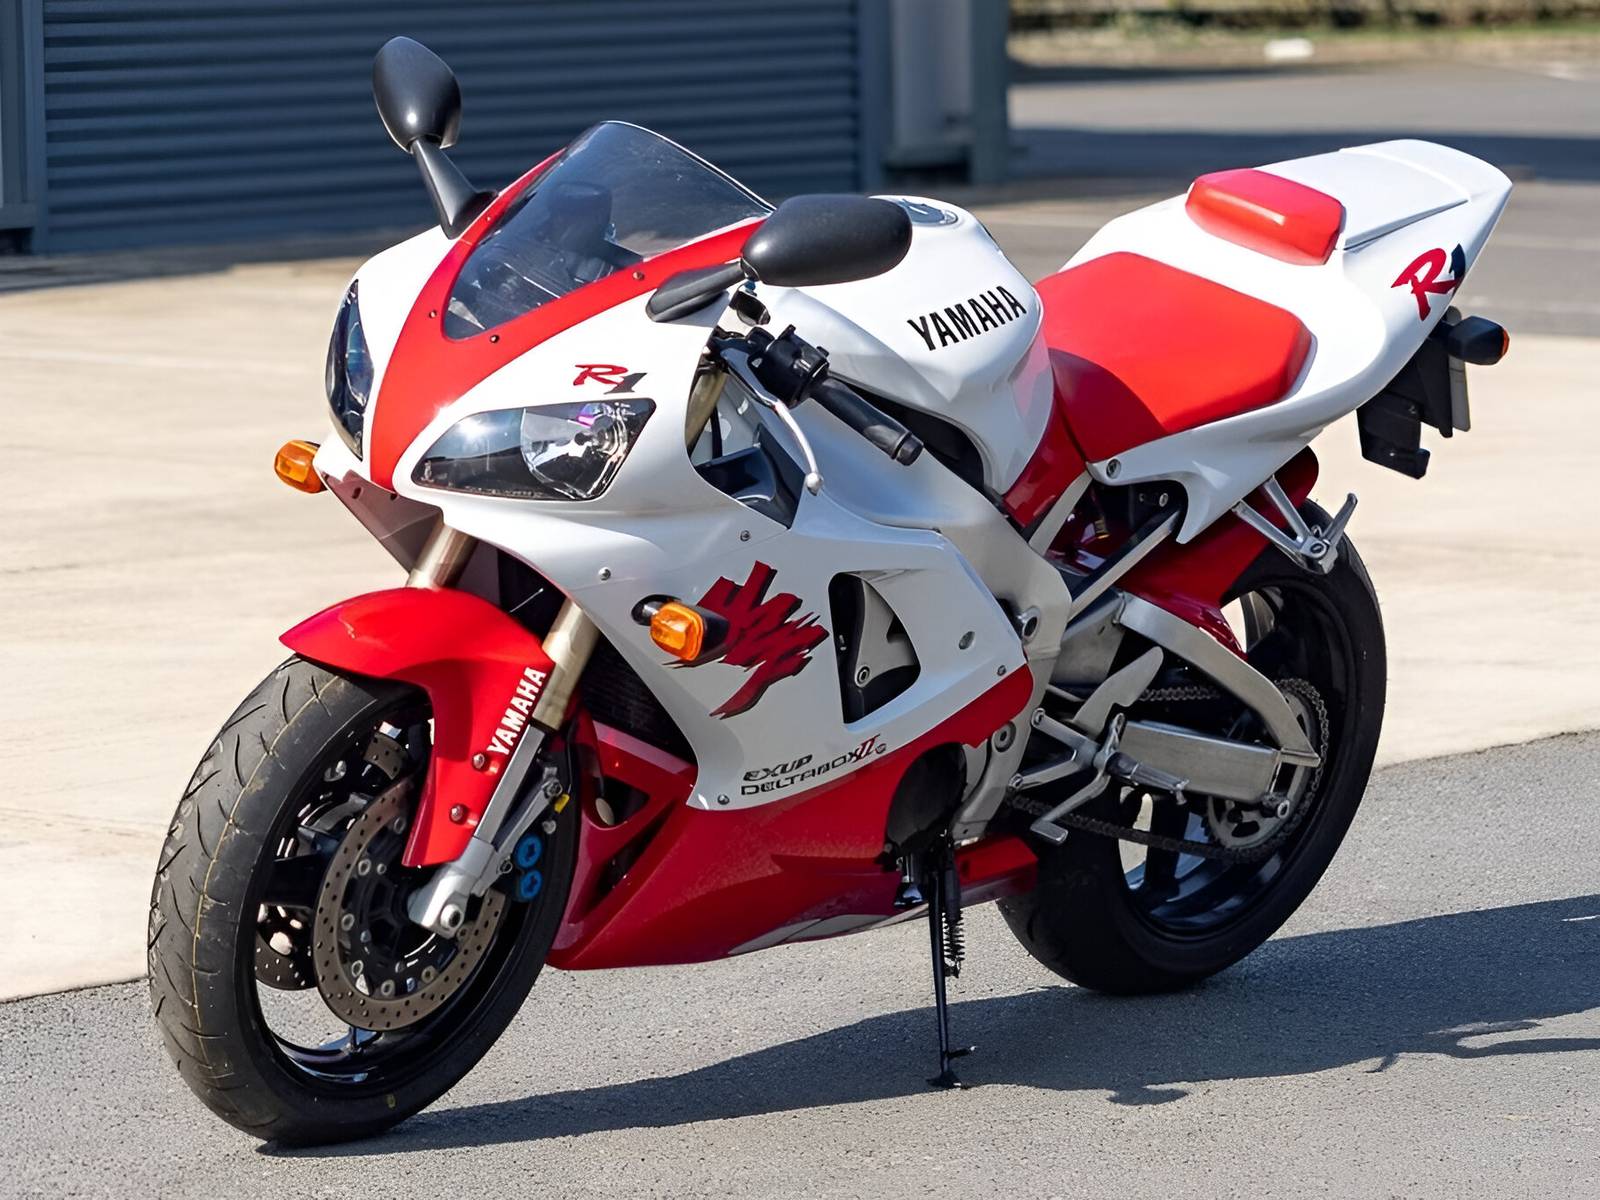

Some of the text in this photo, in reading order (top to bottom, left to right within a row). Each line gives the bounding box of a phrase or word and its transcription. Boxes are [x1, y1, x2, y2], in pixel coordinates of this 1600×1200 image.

[906, 285, 1027, 351] YAMAHA
[573, 364, 648, 395] R1
[486, 667, 547, 756] YAMAHA
[743, 754, 813, 782] EXUP
